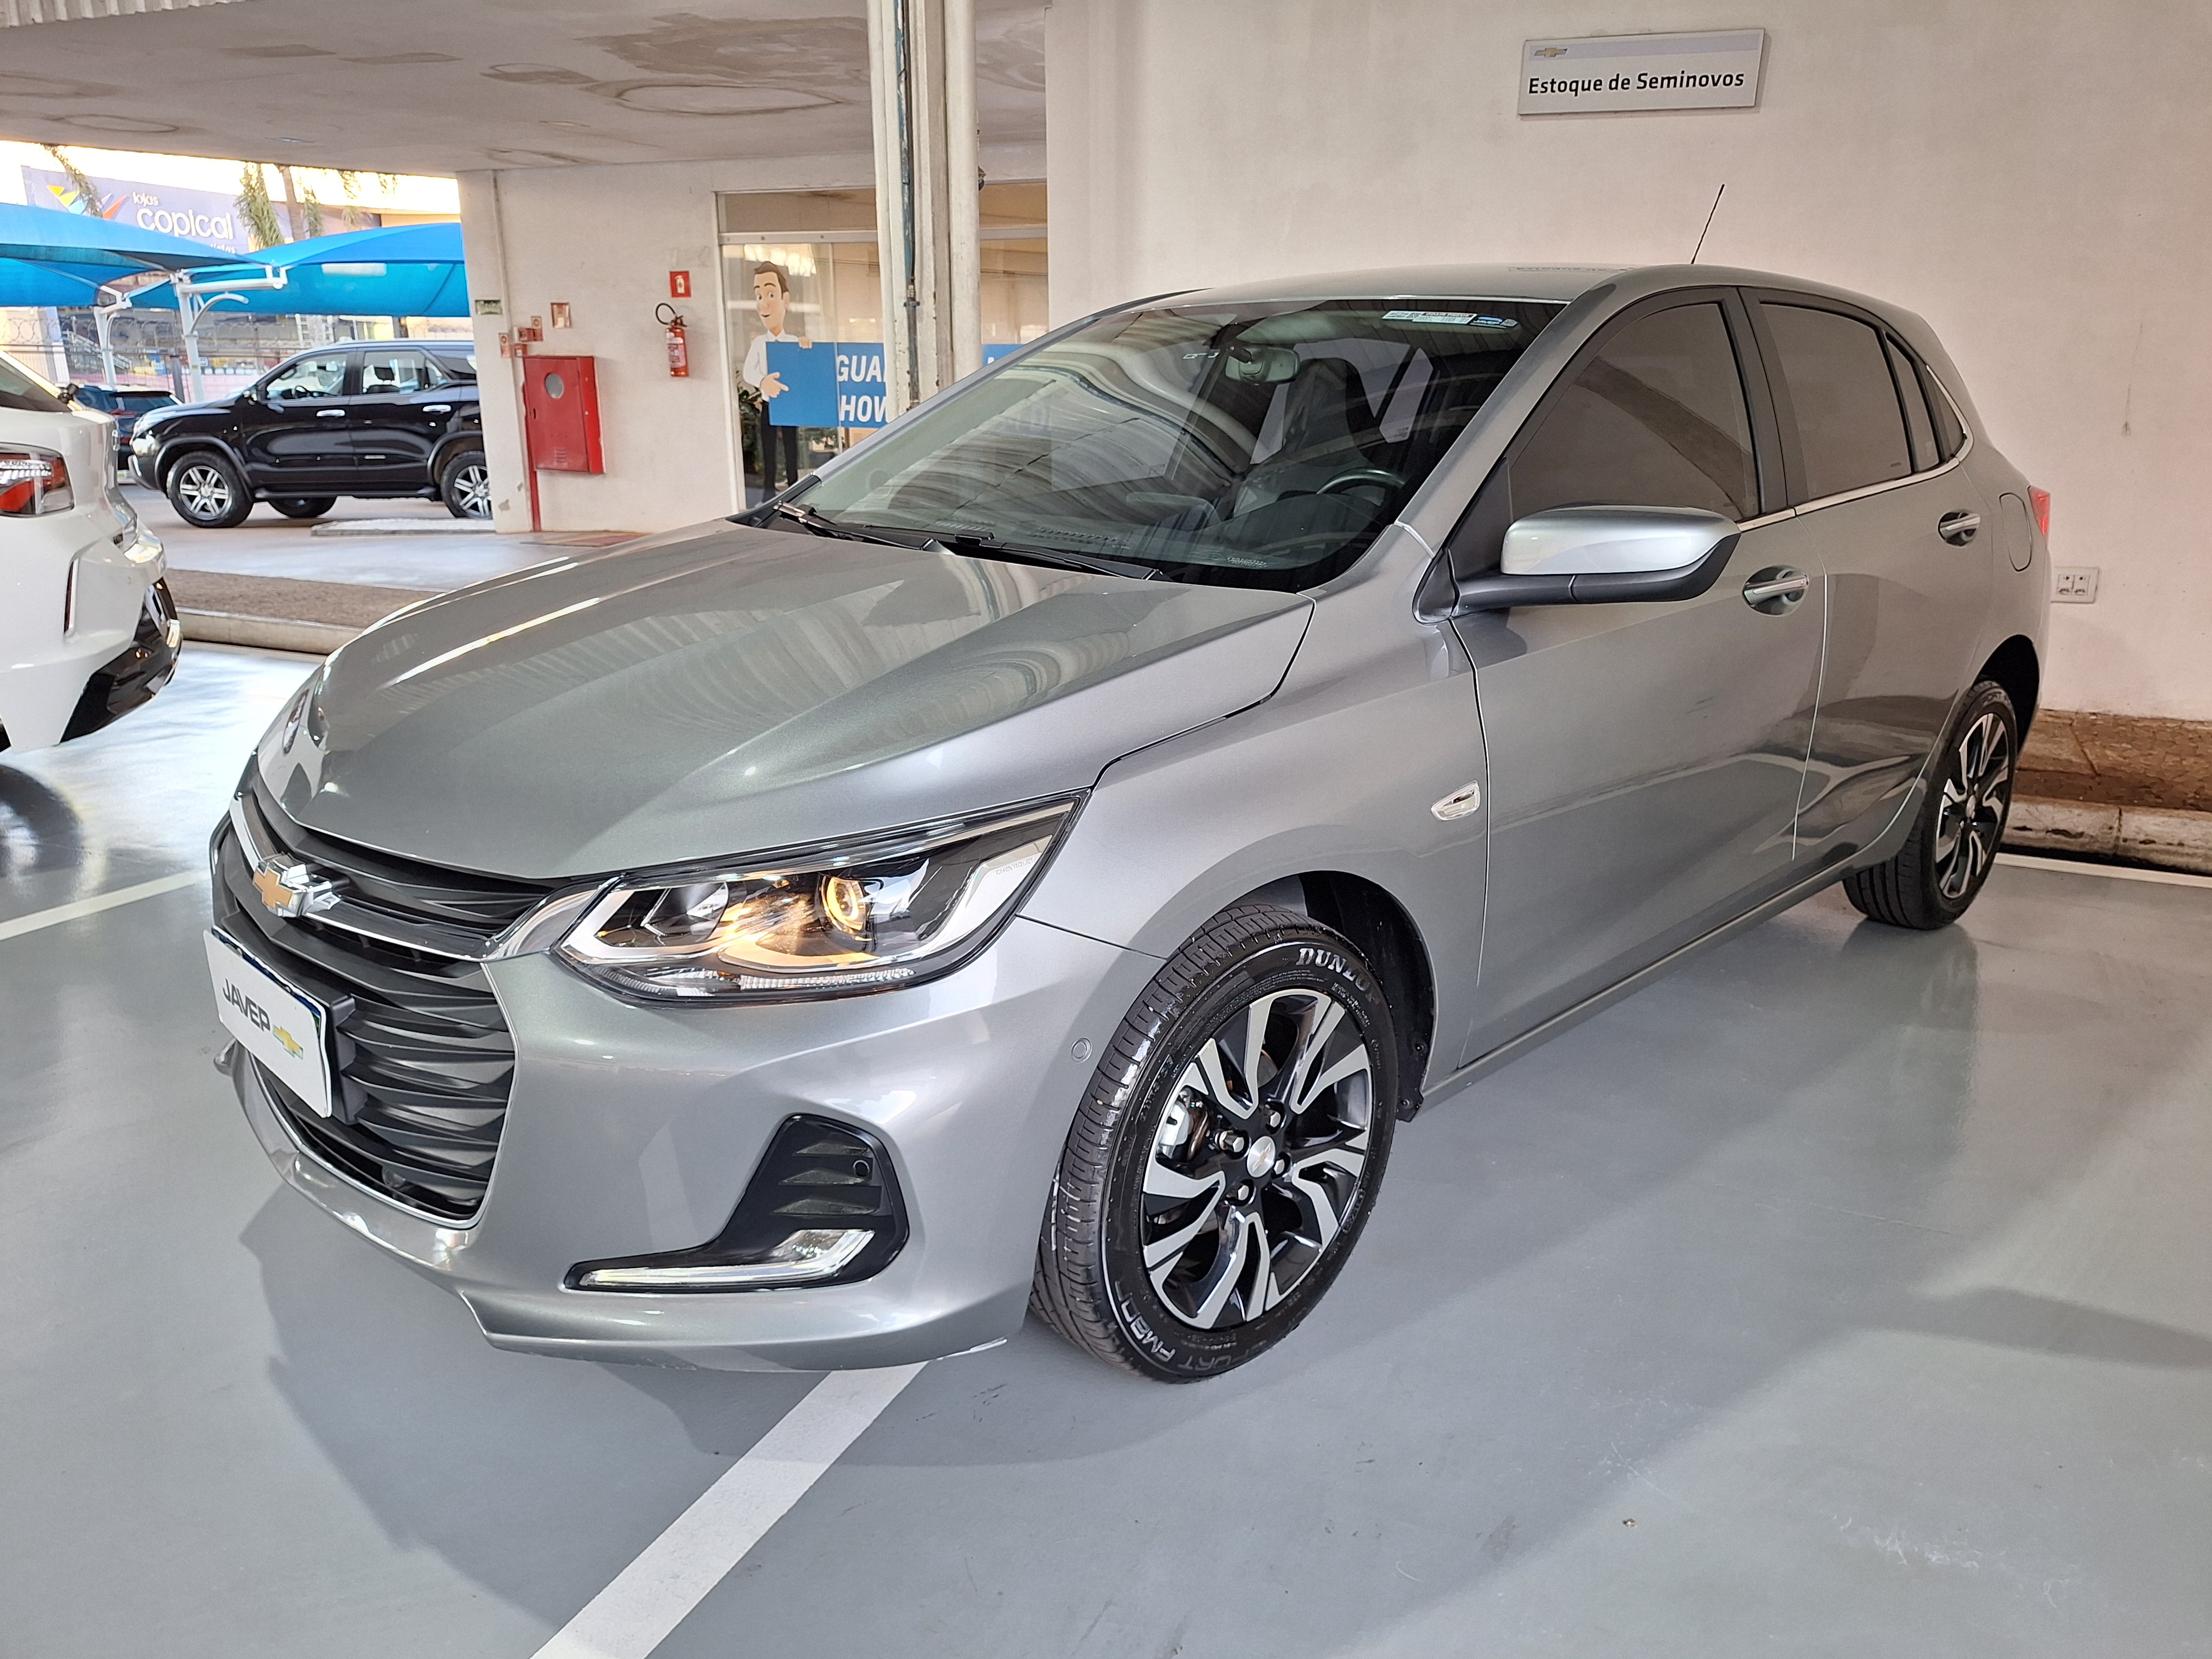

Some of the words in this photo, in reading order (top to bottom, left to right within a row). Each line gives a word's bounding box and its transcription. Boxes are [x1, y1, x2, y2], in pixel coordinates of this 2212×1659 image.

[1529, 78, 1603, 97] Estoque
[1609, 73, 1630, 91] de
[1636, 70, 1744, 89] Seminovos
[132, 191, 159, 207] lojas
[137, 209, 234, 240] copical
[837, 355, 885, 382] GUA
[996, 858, 1034, 874] CHEVROLET
[222, 978, 271, 1032] JAVEP
